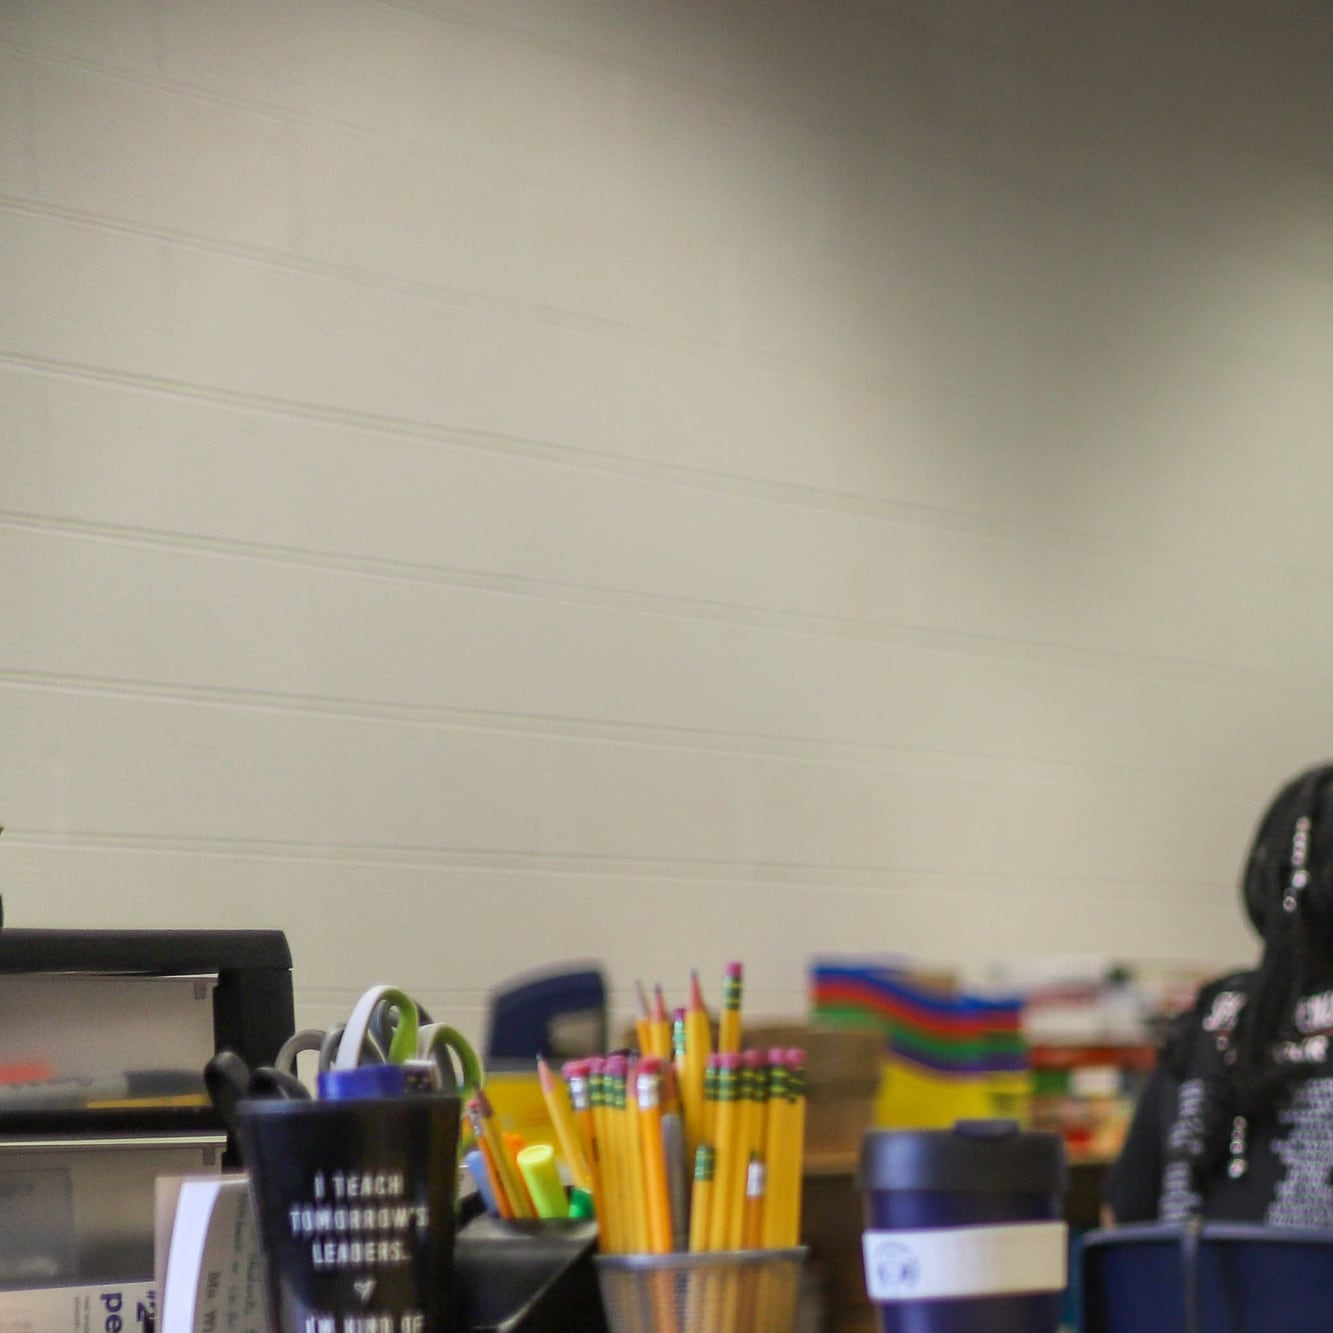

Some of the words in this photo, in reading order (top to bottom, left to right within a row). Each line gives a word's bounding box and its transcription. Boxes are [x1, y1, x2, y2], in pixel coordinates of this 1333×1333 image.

[314, 1173, 325, 1198] I
[332, 1173, 404, 1197] TEACH
[289, 1206, 429, 1231] TOMORROW'S
[312, 1240, 412, 1265] LEADERS.
